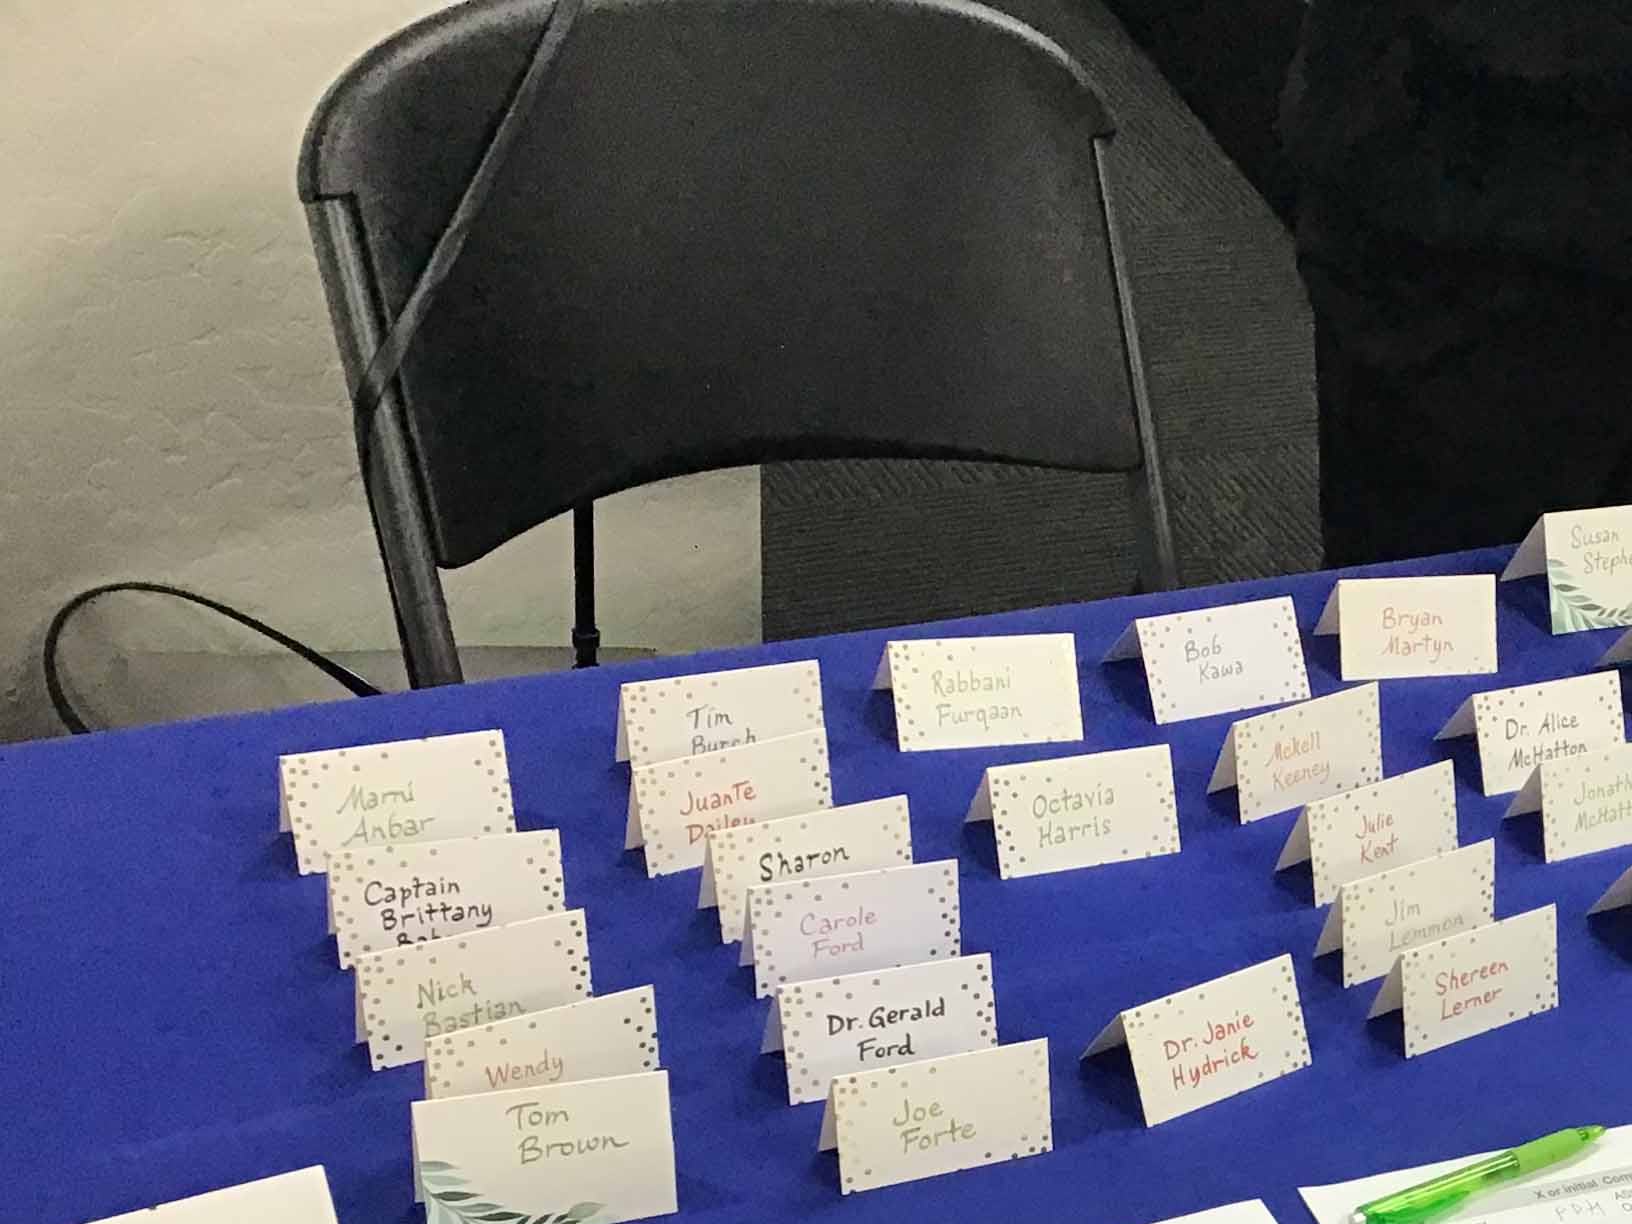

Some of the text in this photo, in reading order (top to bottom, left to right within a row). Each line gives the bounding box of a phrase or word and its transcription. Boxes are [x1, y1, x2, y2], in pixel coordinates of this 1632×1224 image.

[1570, 523, 1620, 549] Susan
[1381, 606, 1444, 635] Bryan
[1184, 633, 1223, 662] Bob
[1381, 633, 1455, 663] Martyn
[930, 667, 1012, 698] Rabbani
[1199, 660, 1244, 683] Kawa
[686, 704, 733, 729] Tim
[1505, 713, 1581, 740] Dr. Alice
[1508, 739, 1589, 769] McHatton
[1272, 757, 1331, 793] Keeney
[679, 779, 757, 816] JuanTe
[1031, 782, 1115, 821] Octavia
[341, 816, 436, 847] Anbar
[1038, 815, 1112, 849] Harris
[1355, 810, 1394, 841] Julie
[758, 845, 850, 882] Sharon
[1360, 835, 1401, 865] Kent
[363, 876, 460, 908] Captain
[380, 902, 493, 931] Brittany
[800, 905, 878, 936] Carole
[1385, 898, 1421, 927] Jim
[811, 932, 864, 960] Ford
[1388, 913, 1465, 953] Lemmon
[417, 972, 479, 1010] Nick
[1435, 958, 1510, 997] Shereen
[422, 999, 528, 1038] Bastian
[826, 996, 947, 1037] Dr. Gerald
[1440, 985, 1504, 1021] Lerner
[856, 1033, 916, 1062] Ford
[1163, 1009, 1256, 1063] Dr. Janie
[486, 1048, 565, 1089] Wendy
[1171, 1038, 1260, 1091] Hydrick
[505, 1101, 570, 1130] Tom
[892, 1098, 944, 1128] Joe
[518, 1133, 631, 1165] Brown
[899, 1119, 977, 1155] Forte
